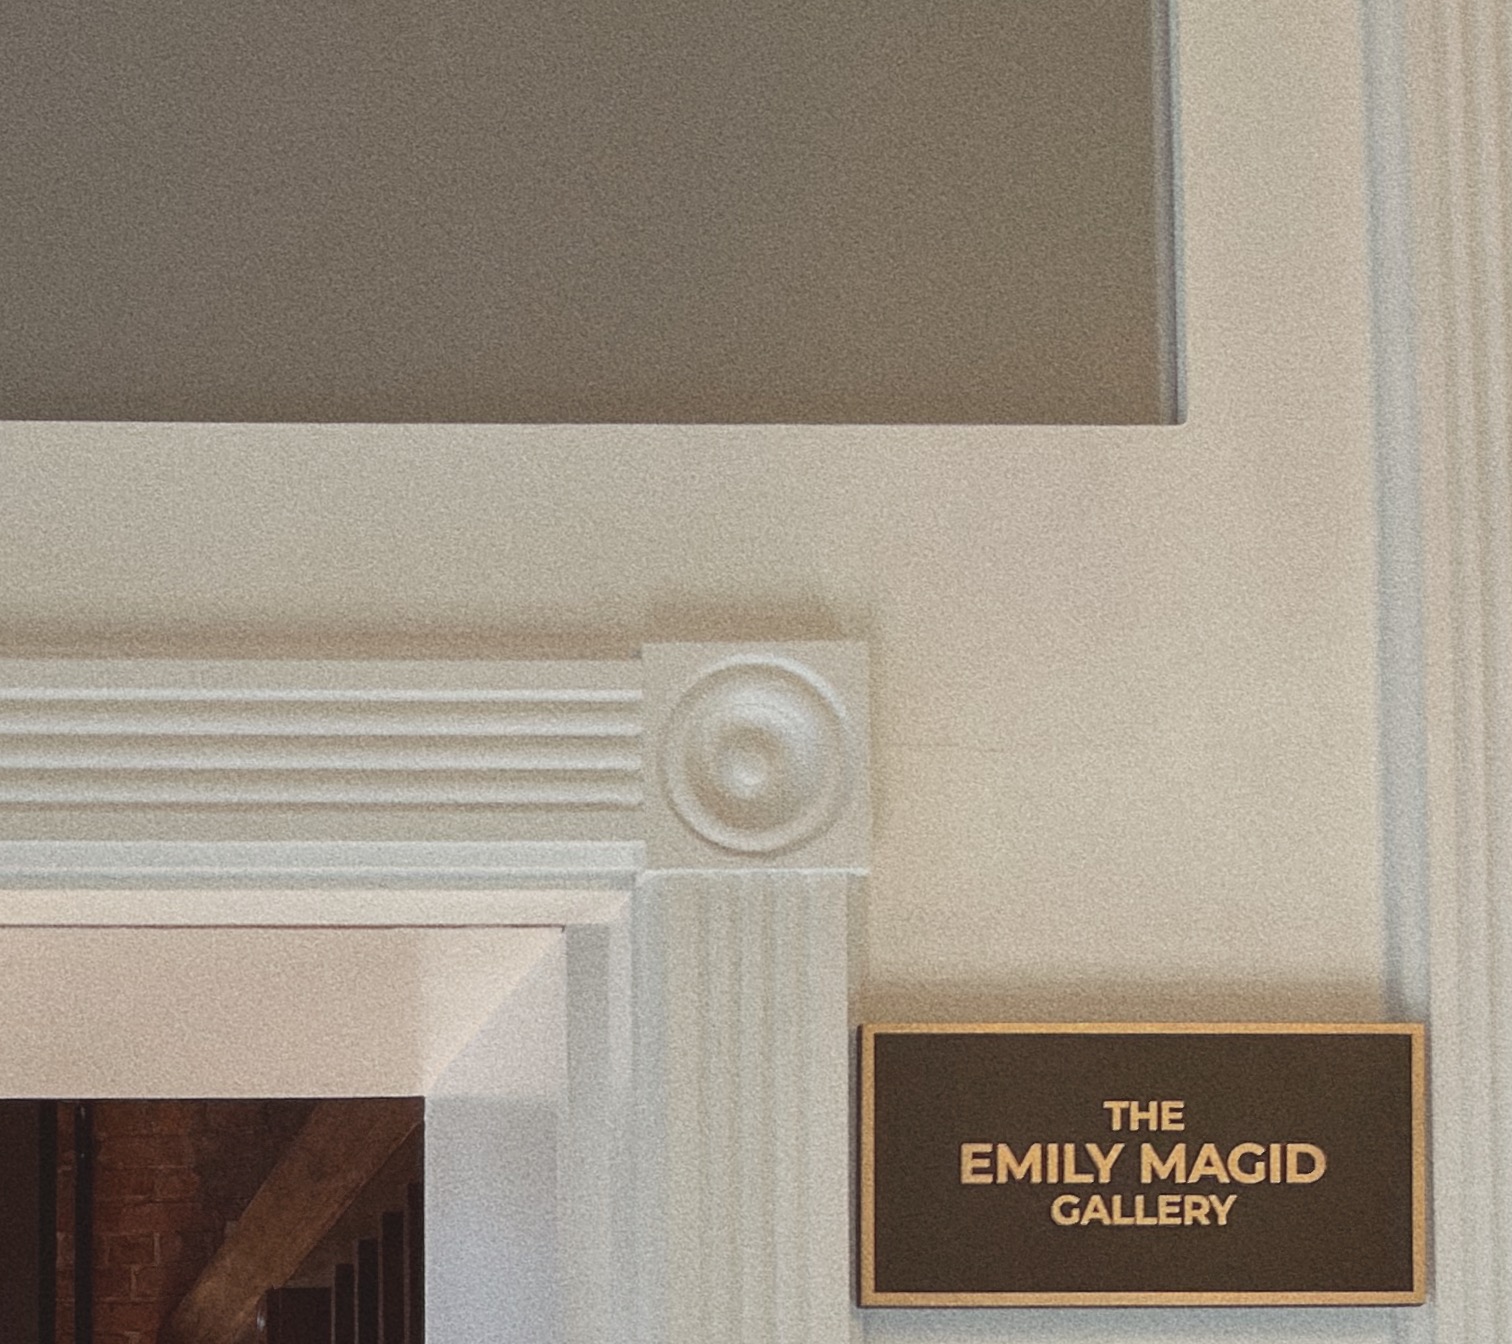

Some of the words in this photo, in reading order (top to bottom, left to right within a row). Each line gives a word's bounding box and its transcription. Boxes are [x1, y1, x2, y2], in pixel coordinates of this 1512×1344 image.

[1103, 1100, 1185, 1132] THE
[960, 1142, 1125, 1185] EMILY
[1140, 1142, 1327, 1184] MAGID
[1050, 1193, 1238, 1226] GALLERY
